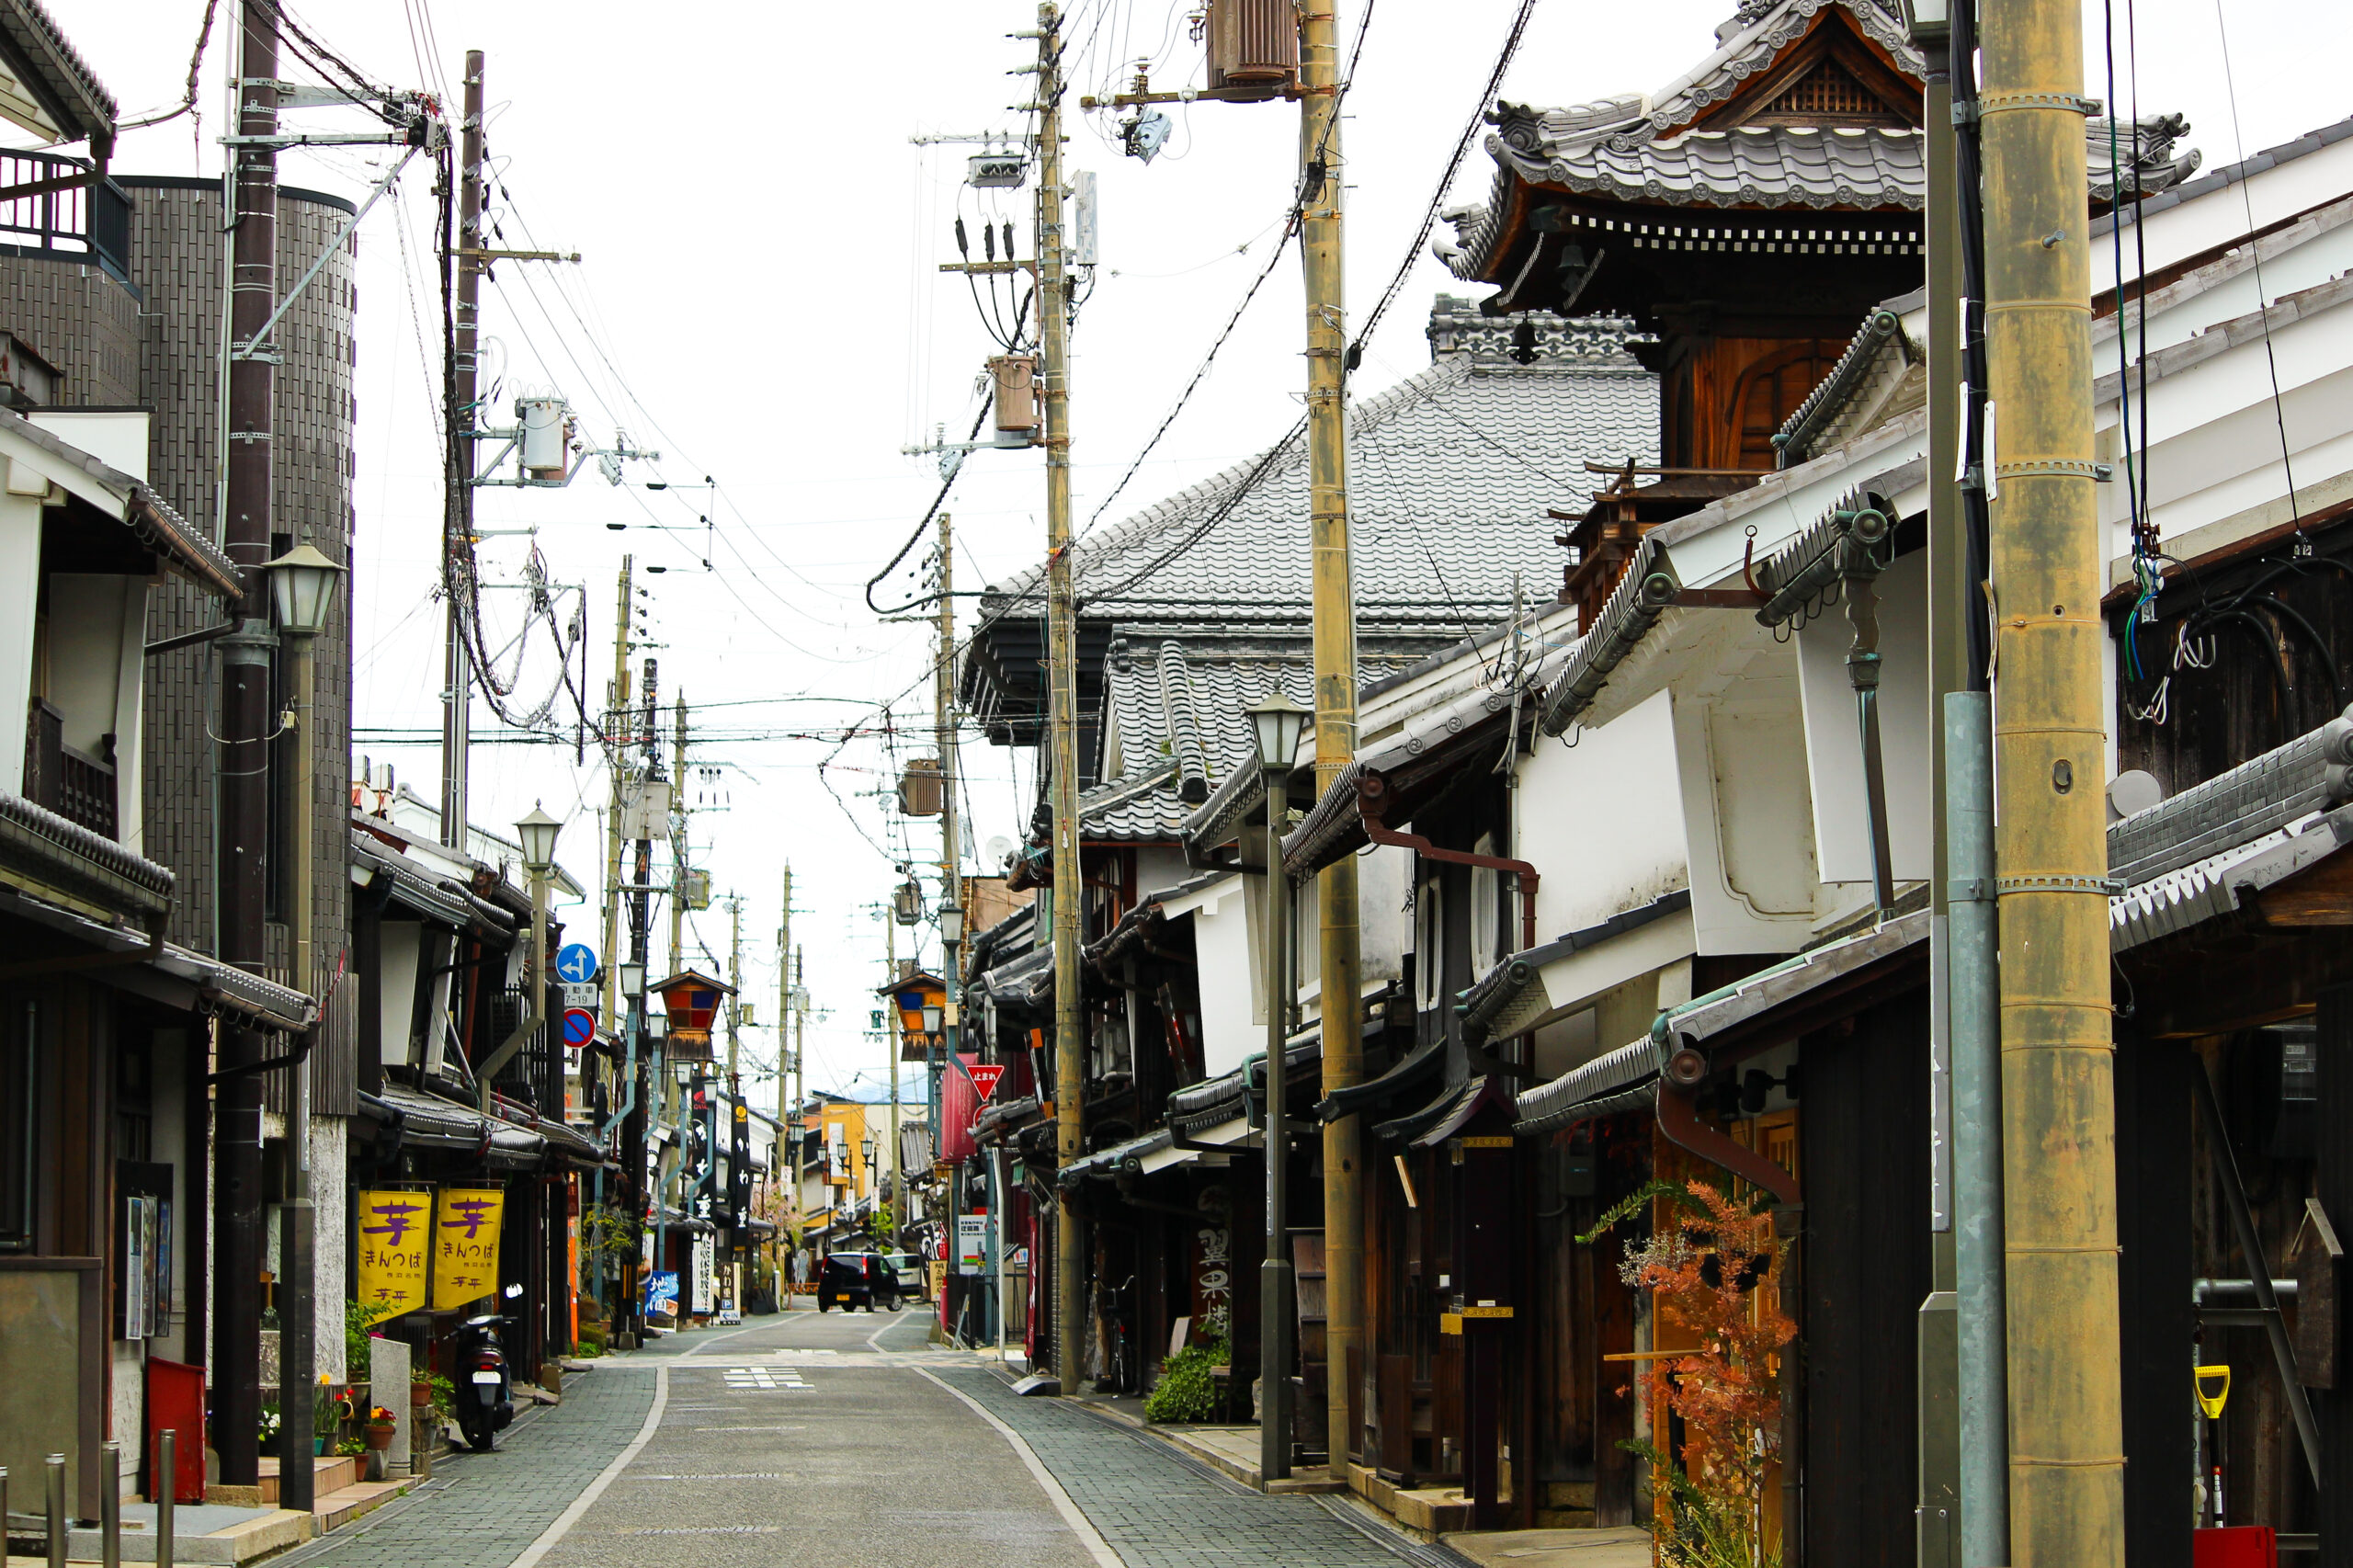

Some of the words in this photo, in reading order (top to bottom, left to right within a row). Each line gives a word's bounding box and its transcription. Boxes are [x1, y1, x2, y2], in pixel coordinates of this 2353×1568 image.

[565, 994, 588, 1005] 7-19
[974, 1071, 997, 1082] 止まれ
[362, 1199, 427, 1246] 芋
[440, 1196, 501, 1239] 芋
[365, 1250, 422, 1268] きんつば
[443, 1242, 494, 1259] きんつば
[450, 1276, 483, 1290] 芋平
[372, 1288, 410, 1303] 芋平
[649, 1275, 670, 1312] 地酒
